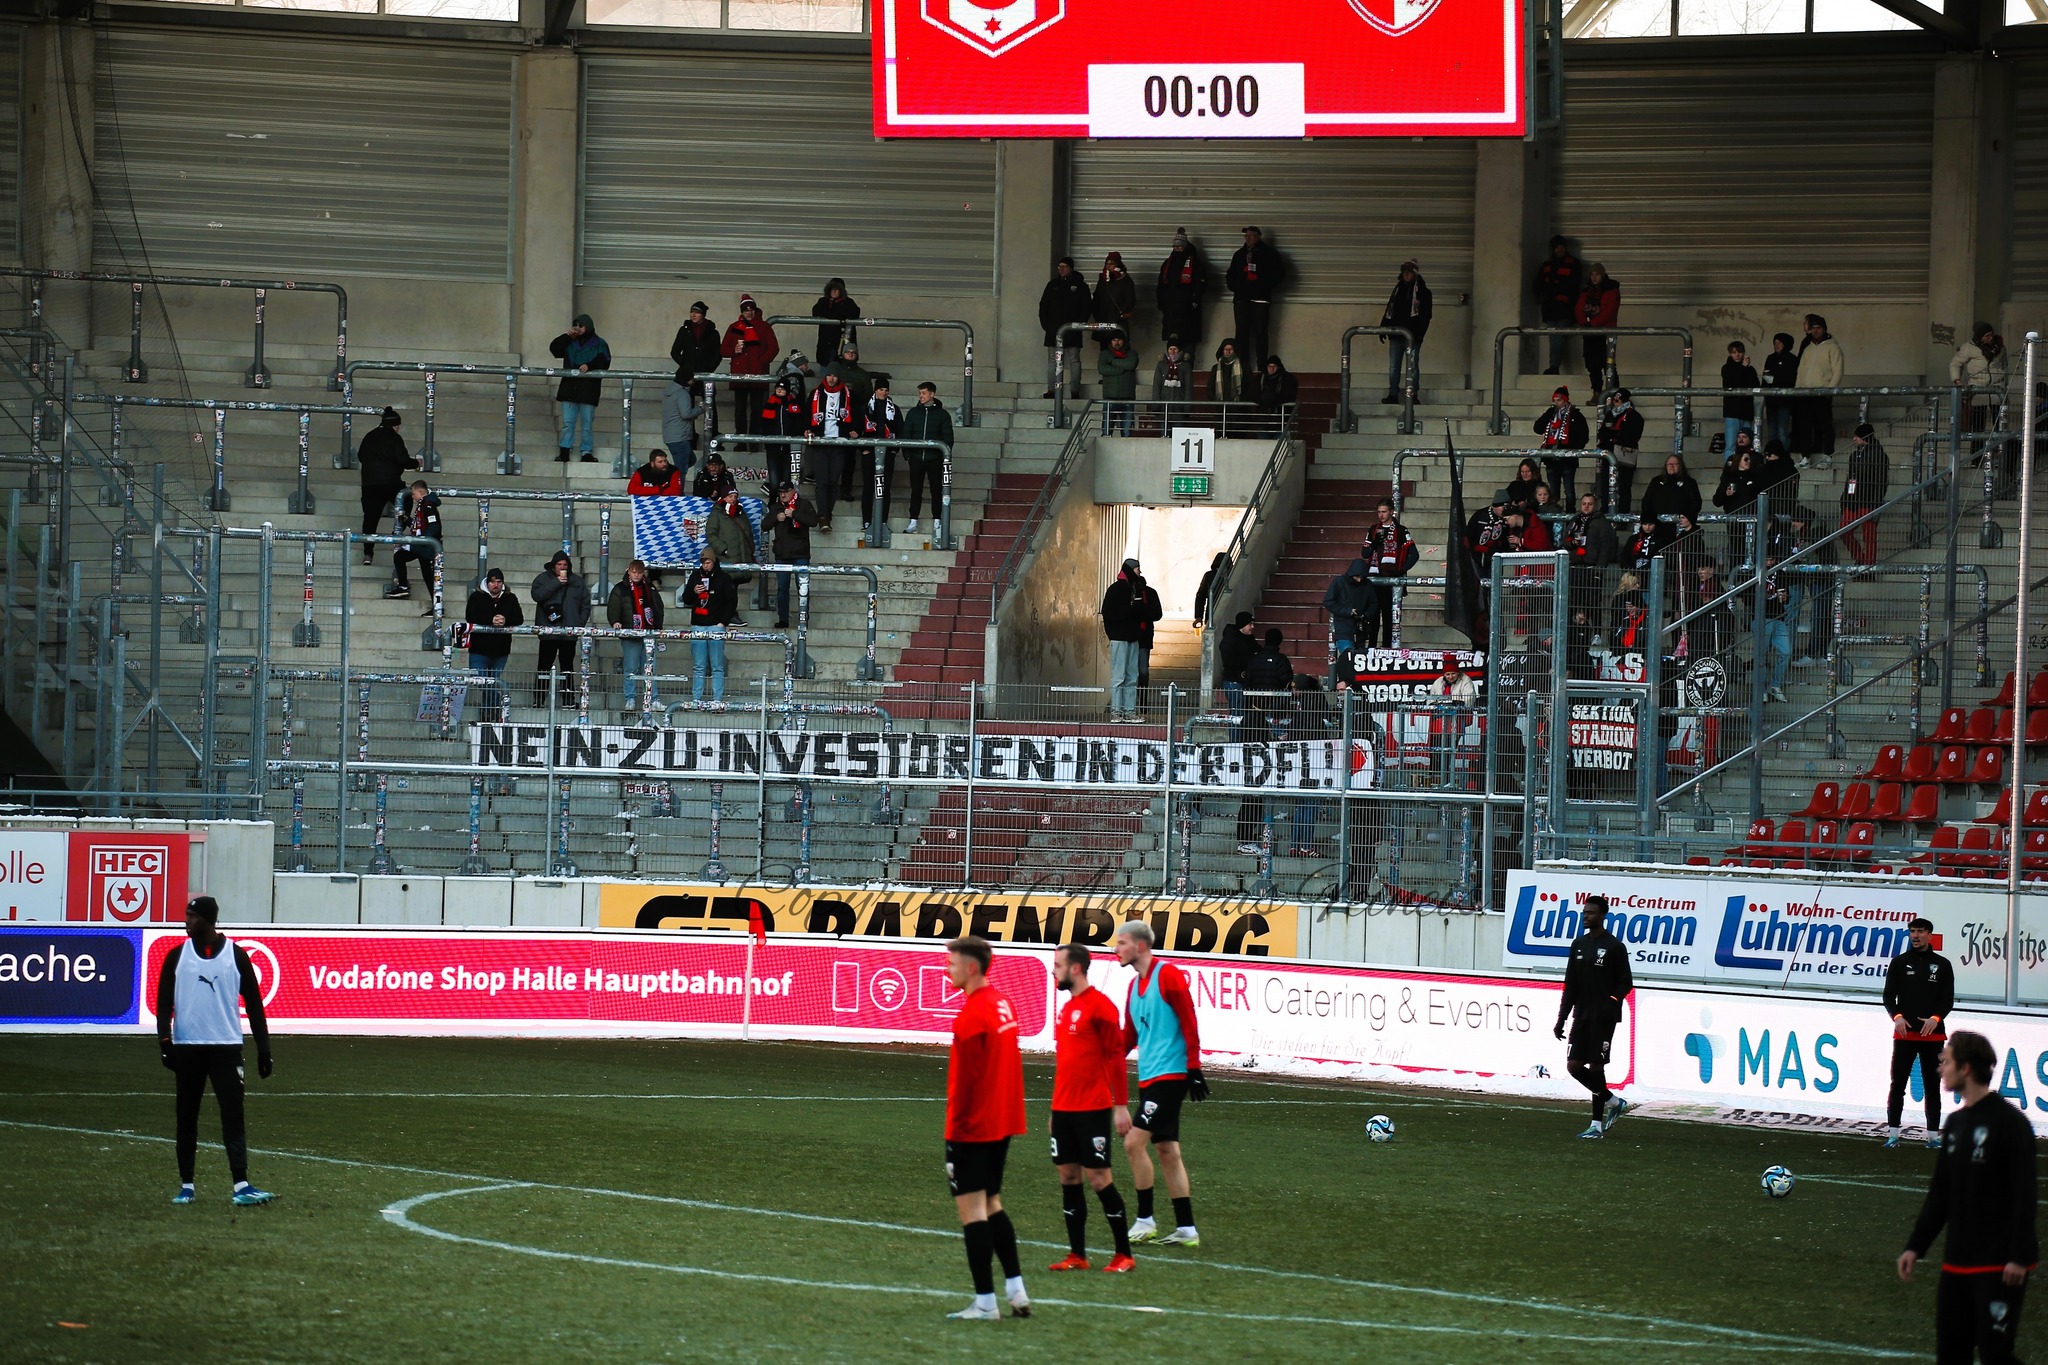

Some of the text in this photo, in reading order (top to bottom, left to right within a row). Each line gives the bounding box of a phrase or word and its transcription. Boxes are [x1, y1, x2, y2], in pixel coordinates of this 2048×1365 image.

[1143, 75, 1260, 118] 00:00
[1181, 438, 1203, 463] 11
[1409, 651, 1443, 661] FREUNDE
[1688, 686, 1723, 707] INGOLSTADT
[1572, 704, 1635, 724] SEKTION
[1571, 723, 1634, 748] STADION
[1573, 748, 1632, 771] VERBOT
[98, 853, 159, 873] HFC
[1575, 892, 1696, 911] Whn-Centrum
[1786, 902, 1918, 922] Wohn-Centrum
[0, 944, 107, 982] ache.
[1635, 950, 1691, 965] Saline
[309, 964, 434, 990] Vodafone
[440, 965, 506, 996] Shop
[512, 965, 577, 991] Halle
[1790, 961, 1888, 978] an der Sali
[1264, 977, 1387, 1031] Catering
[1398, 986, 1418, 1024] &
[1428, 988, 1531, 1033] Events
